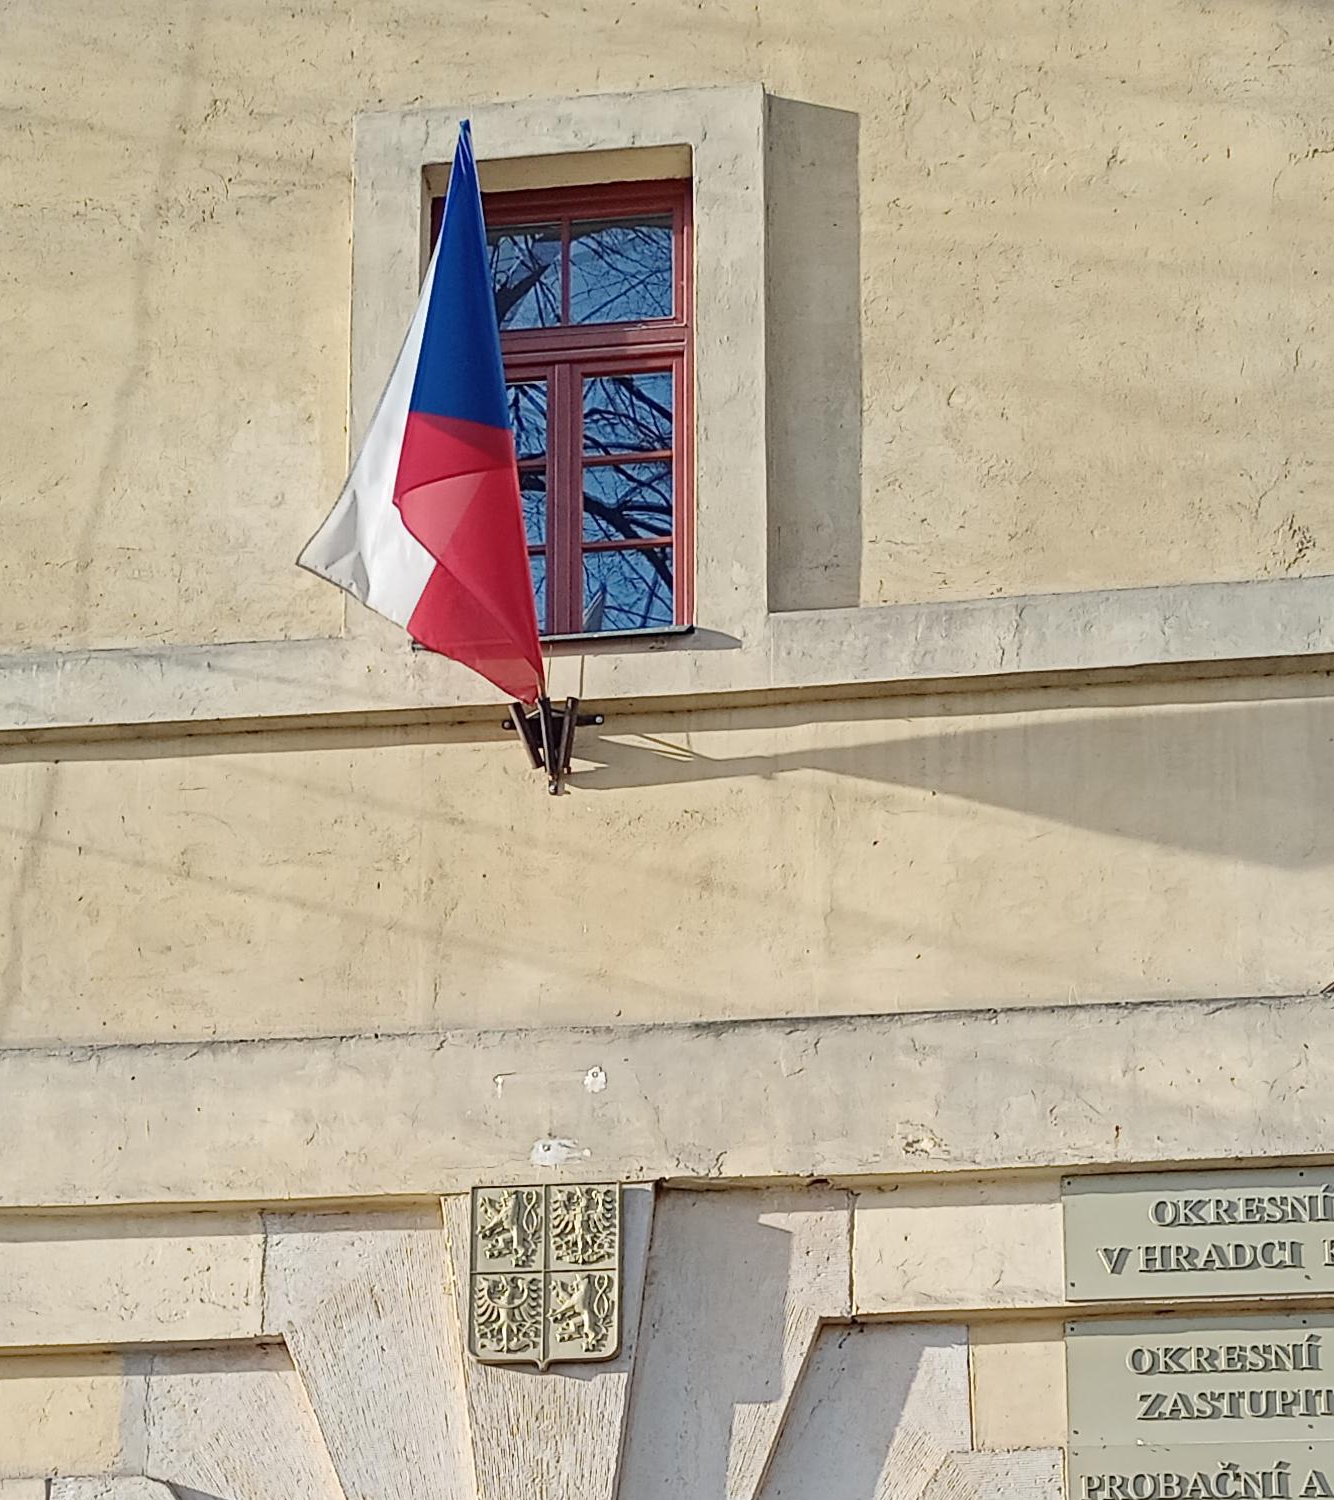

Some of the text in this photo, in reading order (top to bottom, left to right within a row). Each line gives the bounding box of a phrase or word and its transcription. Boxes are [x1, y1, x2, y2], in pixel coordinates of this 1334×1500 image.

[1095, 1246, 1130, 1275] V
[1138, 1239, 1305, 1273] HRADCI
[1126, 1333, 1322, 1375] OKRESNÍ
[1299, 1469, 1334, 1498] A
